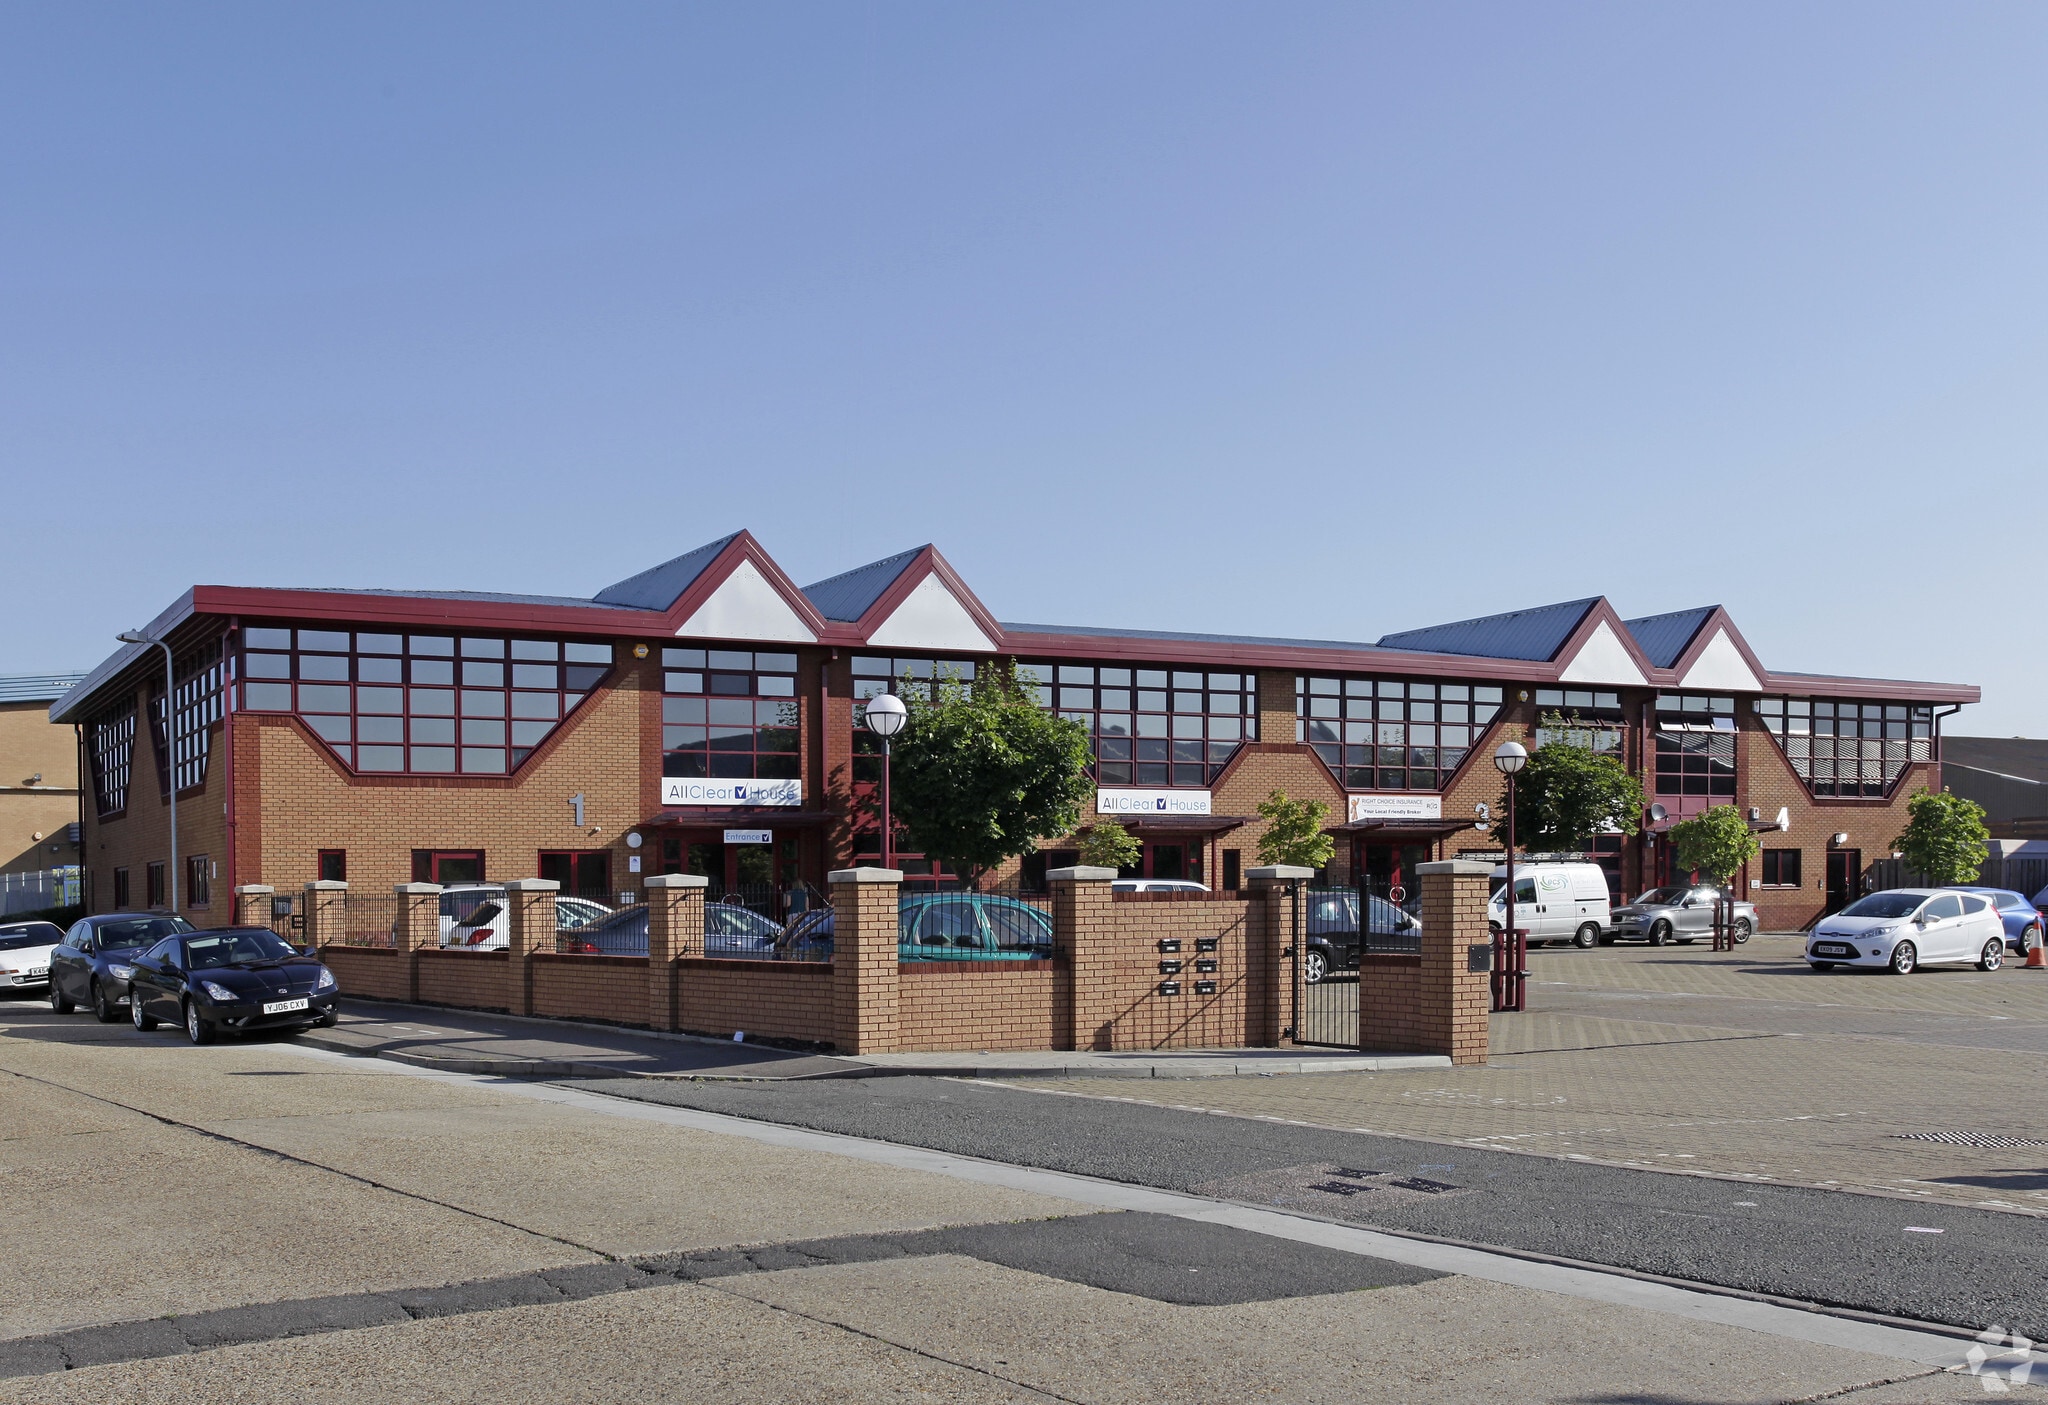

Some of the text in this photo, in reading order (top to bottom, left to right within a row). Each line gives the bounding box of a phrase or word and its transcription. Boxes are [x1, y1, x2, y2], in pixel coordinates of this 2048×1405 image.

[669, 785, 795, 800] AllClear House
[568, 793, 585, 826] 1
[1103, 797, 1207, 811] AllClear House
[1475, 802, 1489, 831] 3
[1776, 807, 1789, 831] 4
[725, 832, 761, 841] Entrance
[267, 1000, 305, 1012] YJ06 CXV
